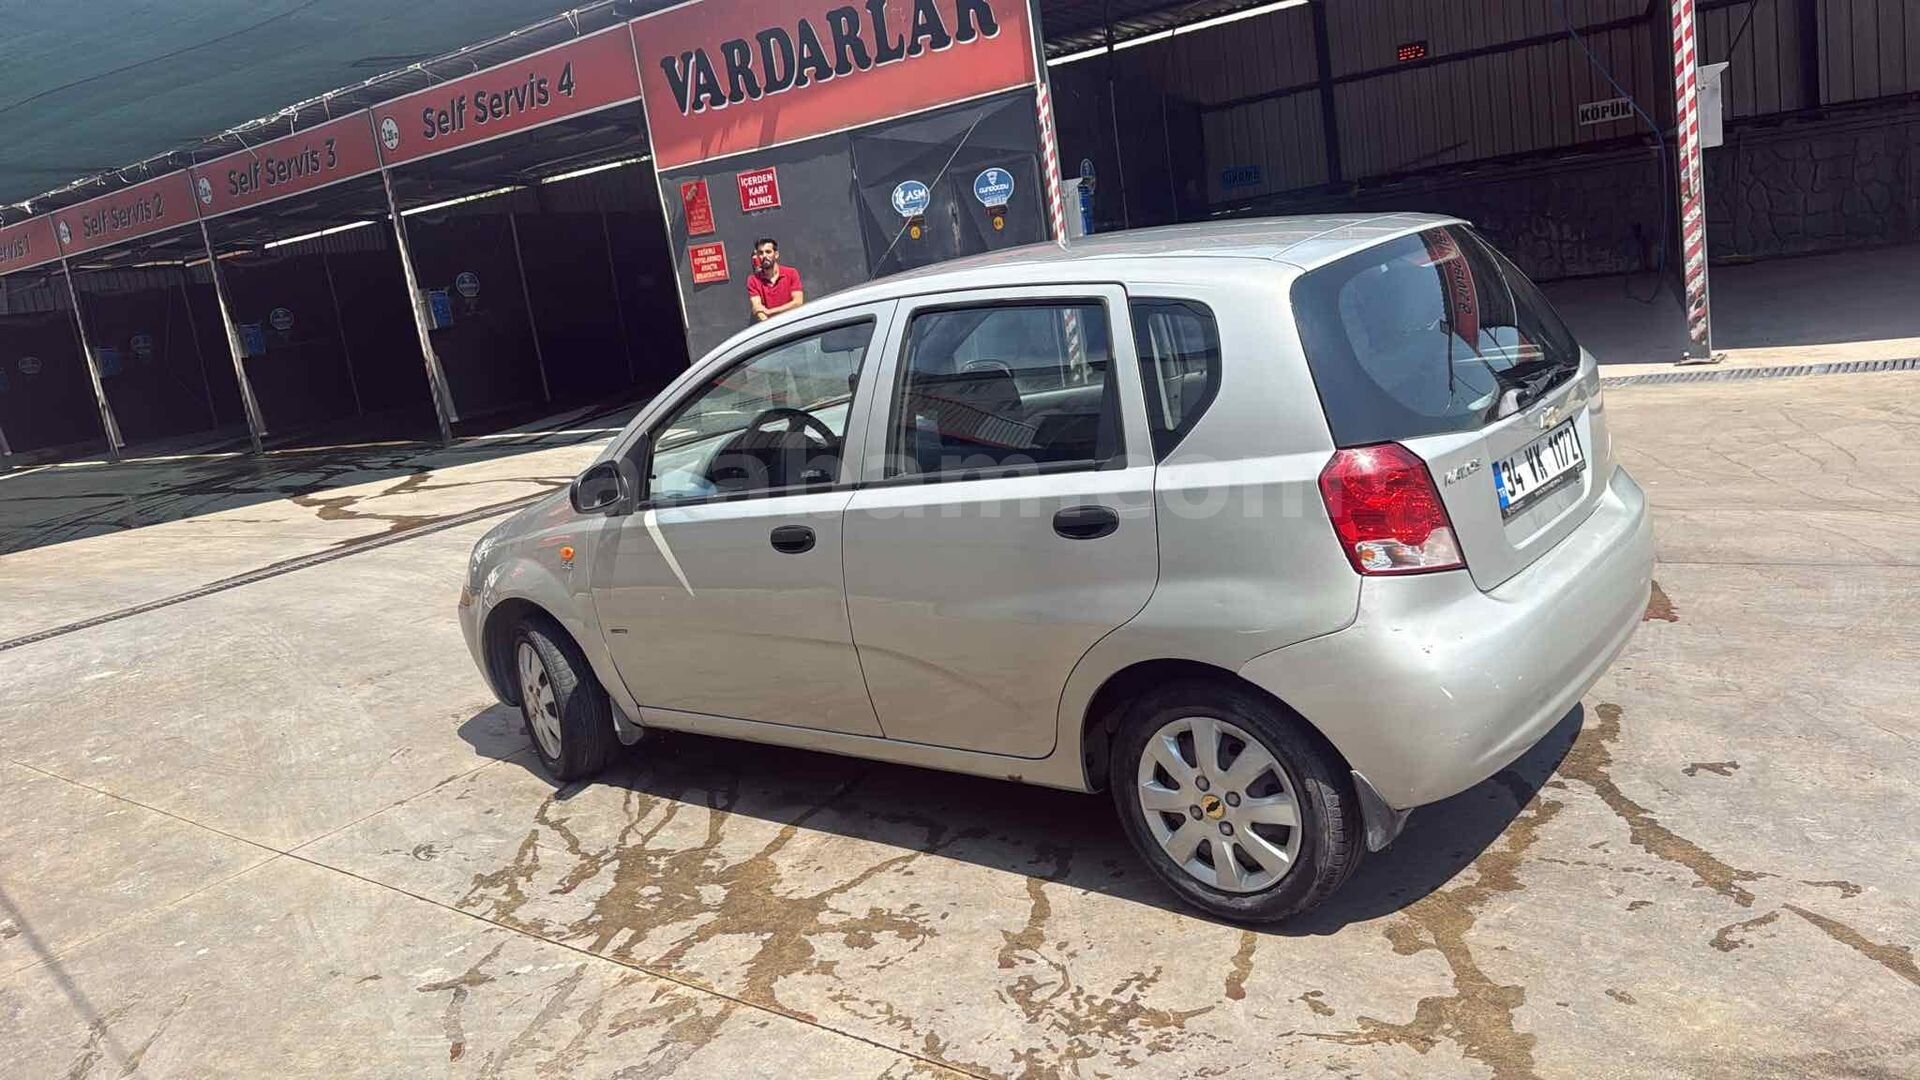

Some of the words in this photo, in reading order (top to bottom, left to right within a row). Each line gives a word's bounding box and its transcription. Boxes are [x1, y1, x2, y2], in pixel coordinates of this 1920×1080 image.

[660, 0, 1001, 117] VARDARLAR
[422, 95, 467, 141] Self
[474, 73, 551, 126] Servis
[558, 61, 576, 98] 4
[1580, 101, 1632, 122] KÖPÜK
[229, 159, 263, 197] Self
[265, 145, 320, 187] Servis
[325, 137, 337, 170] 3
[748, 185, 769, 196] KART
[82, 211, 109, 240] Self
[111, 197, 151, 232] Servis
[151, 193, 165, 219] 2
[748, 195, 773, 208] ALINIZ
[1502, 457, 1526, 498] 34
[1548, 428, 1580, 470] 1172
